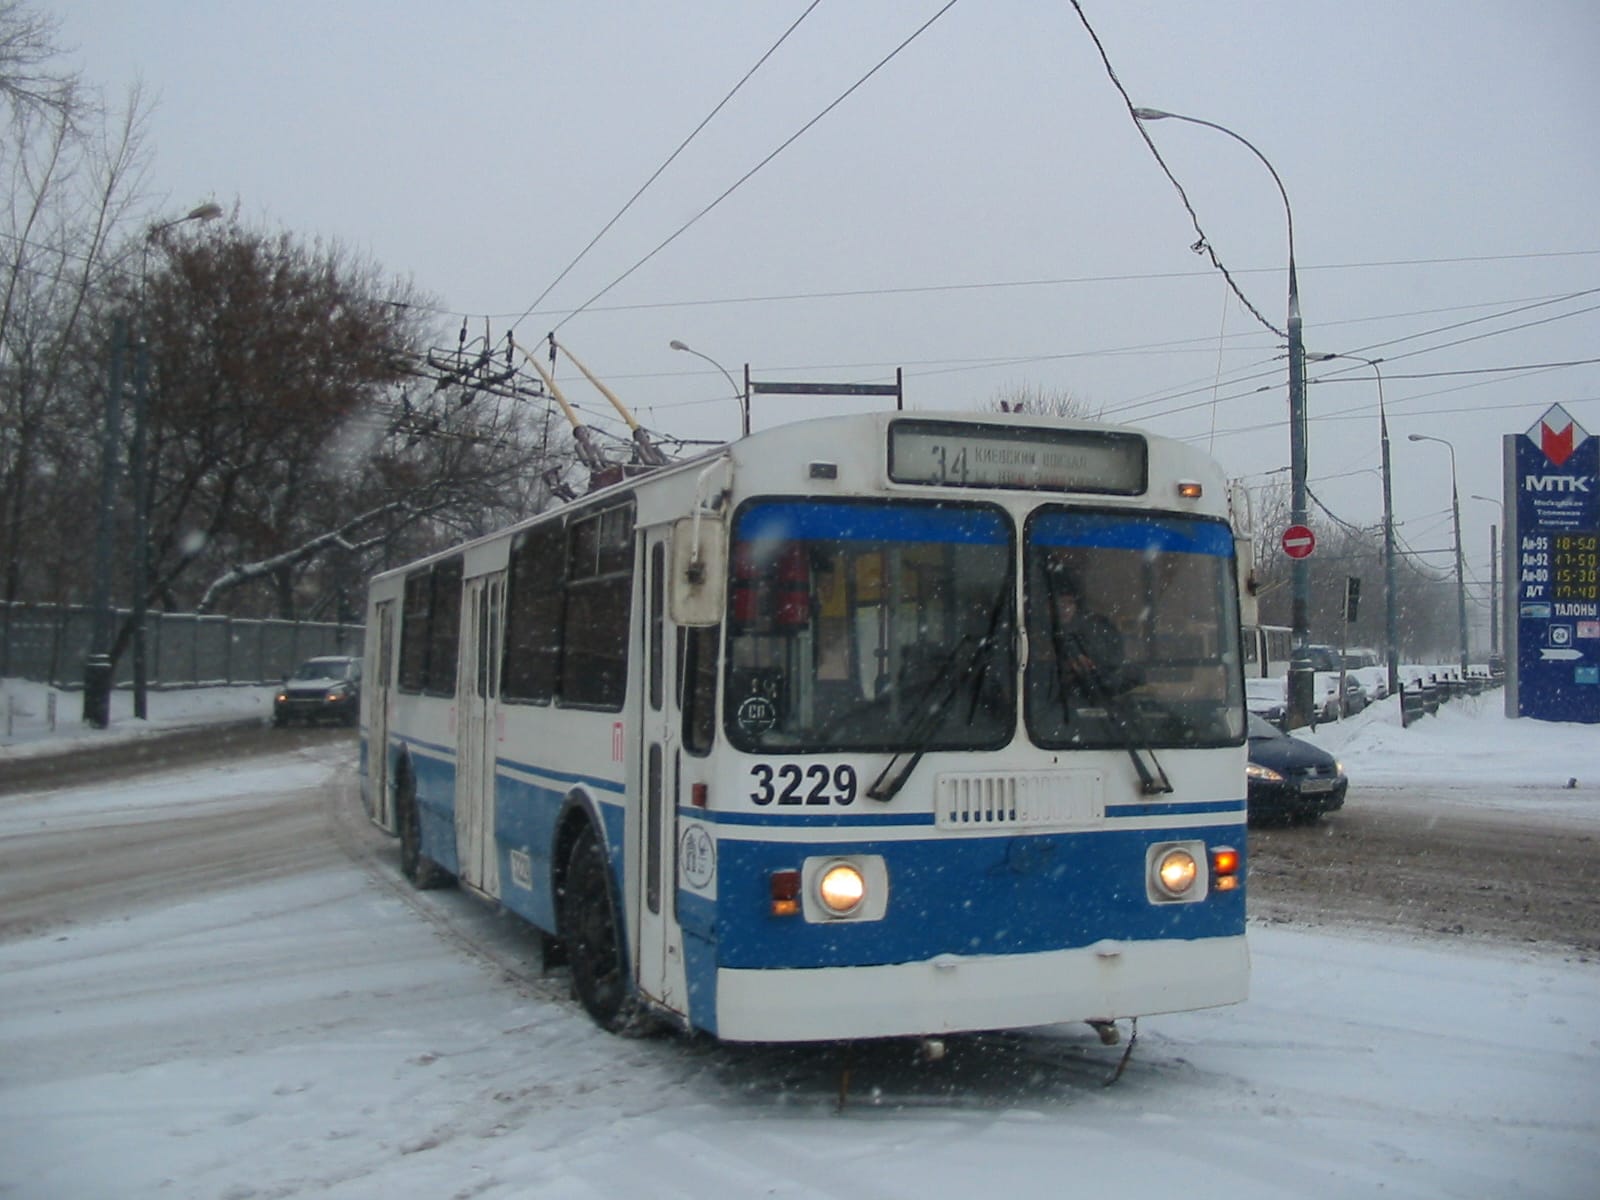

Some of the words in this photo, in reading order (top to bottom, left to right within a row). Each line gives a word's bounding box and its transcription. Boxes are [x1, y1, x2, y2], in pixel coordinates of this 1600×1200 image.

[931, 445, 969, 484] 34
[1525, 475, 1589, 492] МТК
[1554, 603, 1597, 616] ТАЛОНЫ
[750, 764, 857, 806] 3229
